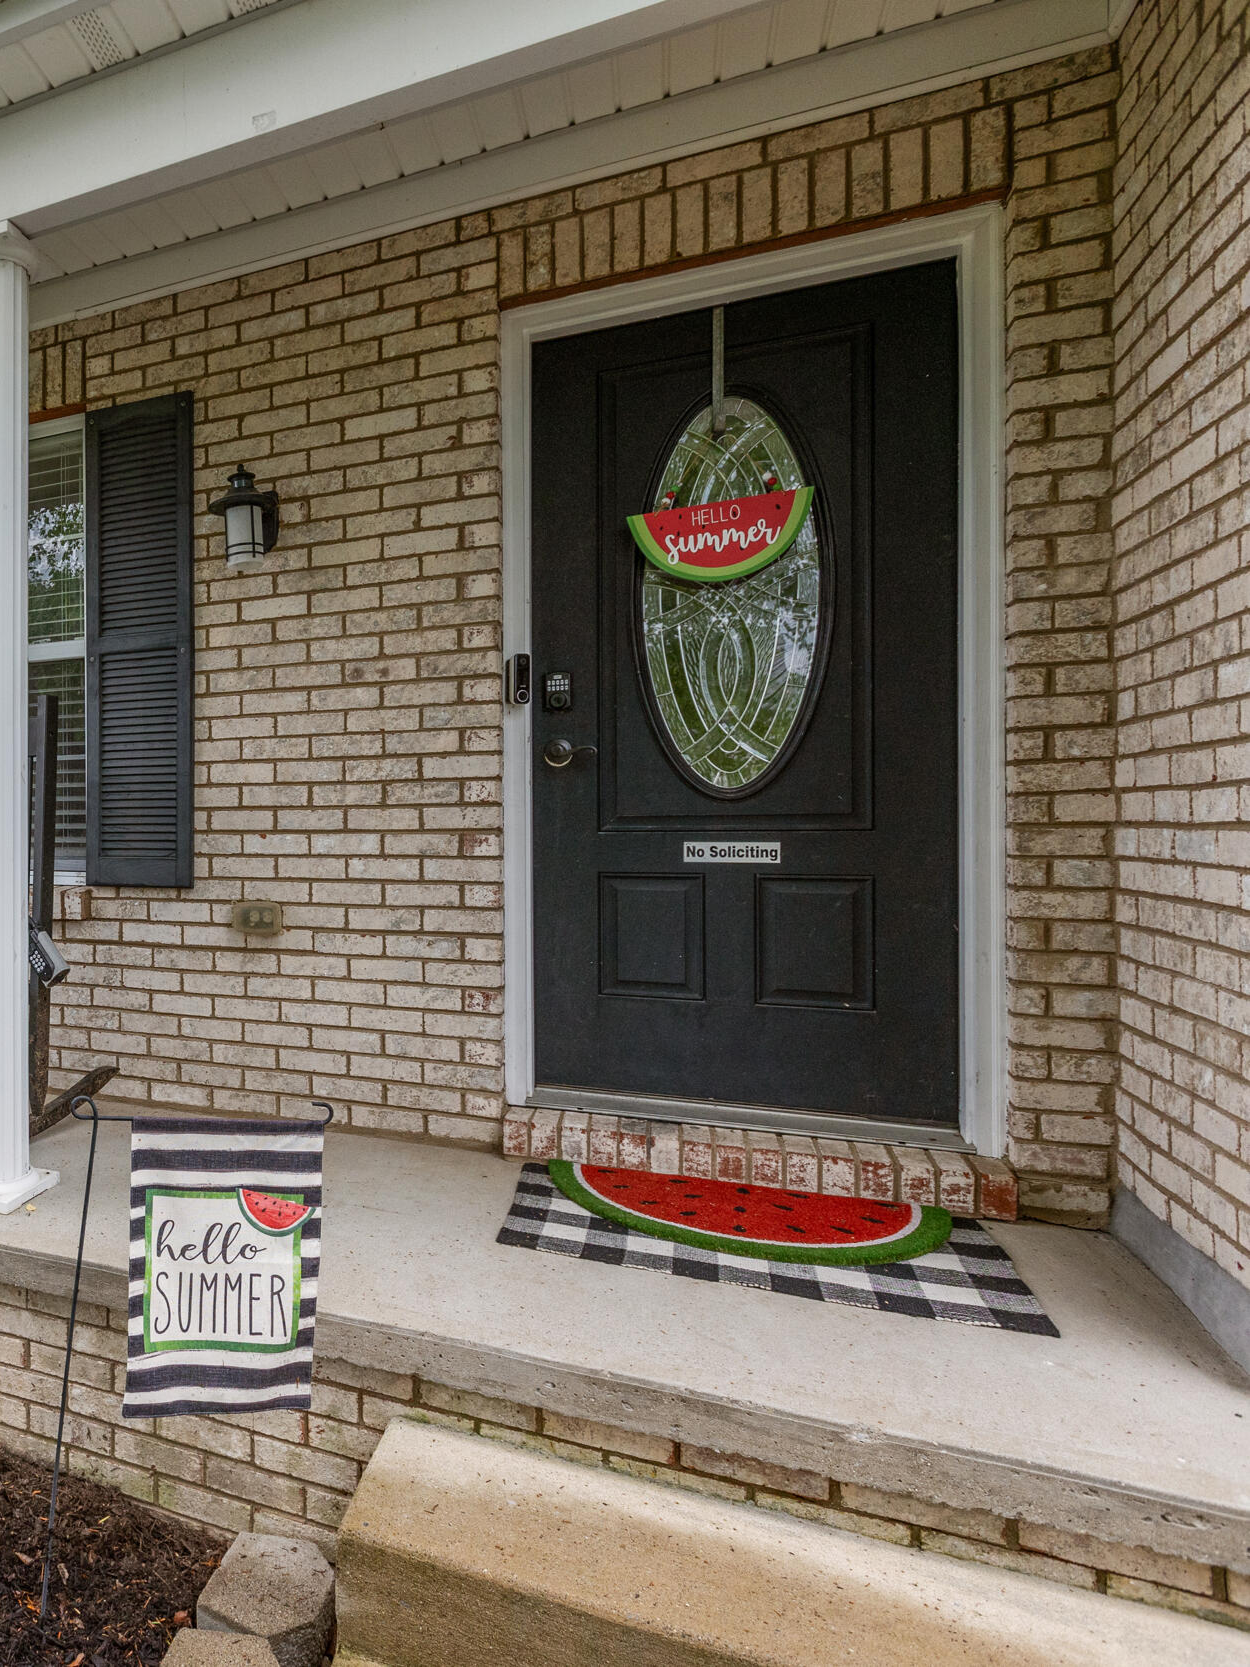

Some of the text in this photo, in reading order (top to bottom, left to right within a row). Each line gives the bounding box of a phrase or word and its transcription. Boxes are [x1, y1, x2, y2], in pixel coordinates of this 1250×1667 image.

[691, 504, 741, 527] HELLO
[665, 518, 781, 565] summer
[686, 845, 778, 861] No Soliciting
[156, 1219, 267, 1265] hello
[154, 1271, 288, 1338] SUMMER
